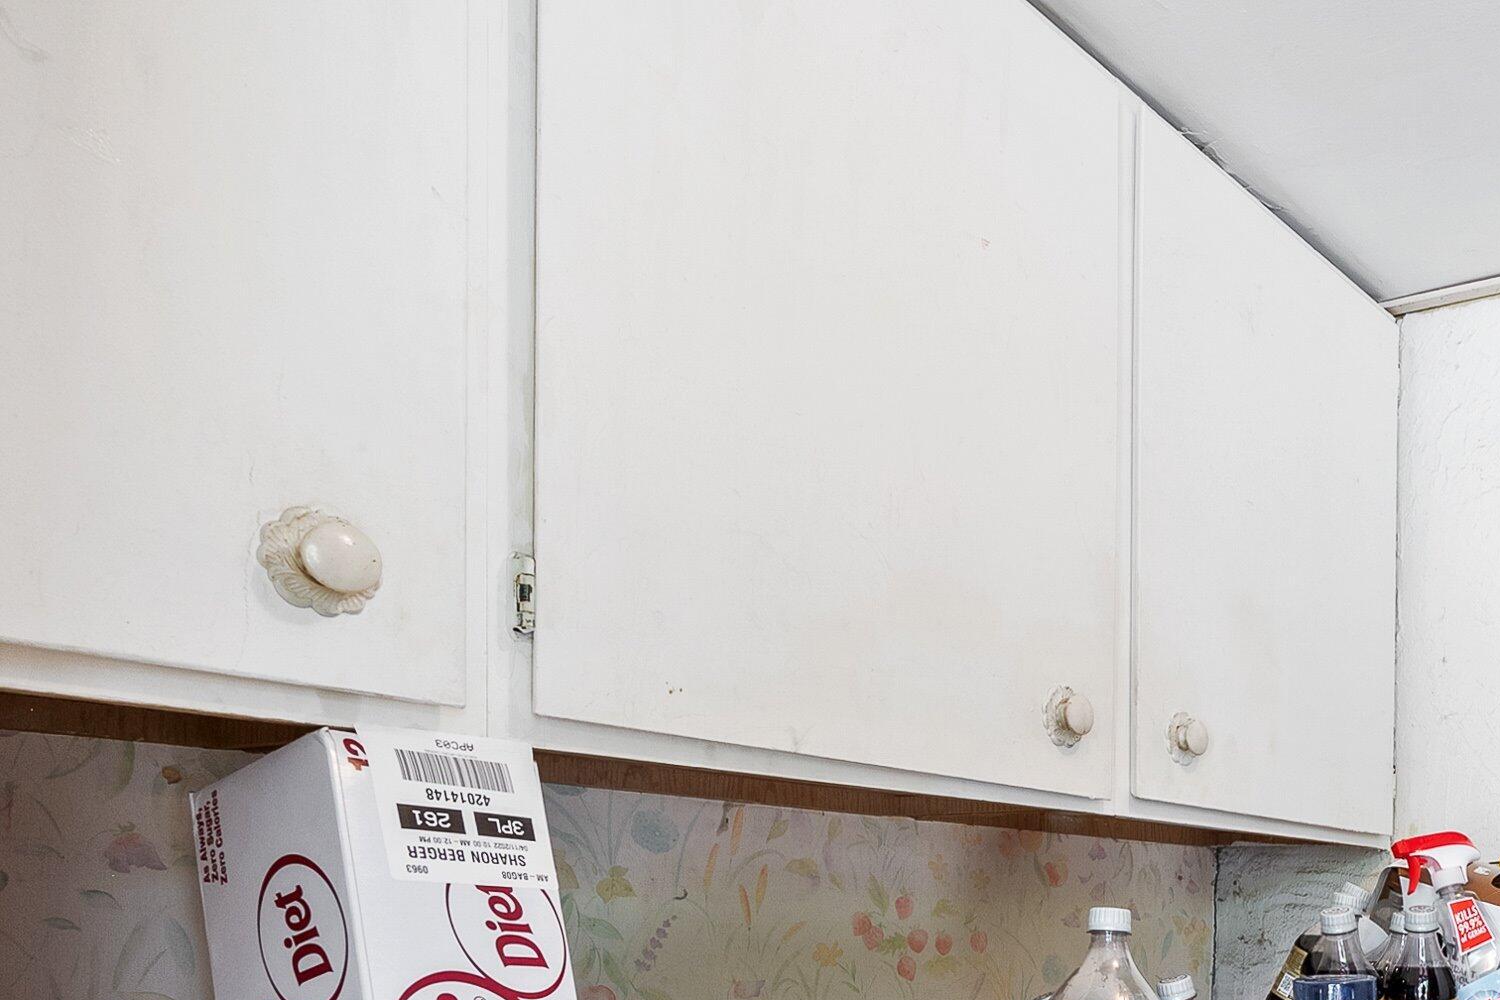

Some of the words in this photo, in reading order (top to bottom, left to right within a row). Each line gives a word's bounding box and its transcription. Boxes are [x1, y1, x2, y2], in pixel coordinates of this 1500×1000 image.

[425, 788, 491, 807] 42014148
[203, 801, 214, 846] Sugar,
[211, 789, 223, 848] Calories
[412, 809, 451, 829] 261
[487, 817, 525, 836] 3PL
[406, 845, 466, 862] BERGER
[471, 851, 527, 867] SHARON
[203, 865, 211, 883] As
[211, 849, 219, 883] Zero
[219, 851, 228, 885] Zero
[406, 864, 429, 874] 0963
[1454, 905, 1479, 925] KILLS
[1458, 916, 1483, 933] 99.9%
[274, 884, 334, 987] Diet
